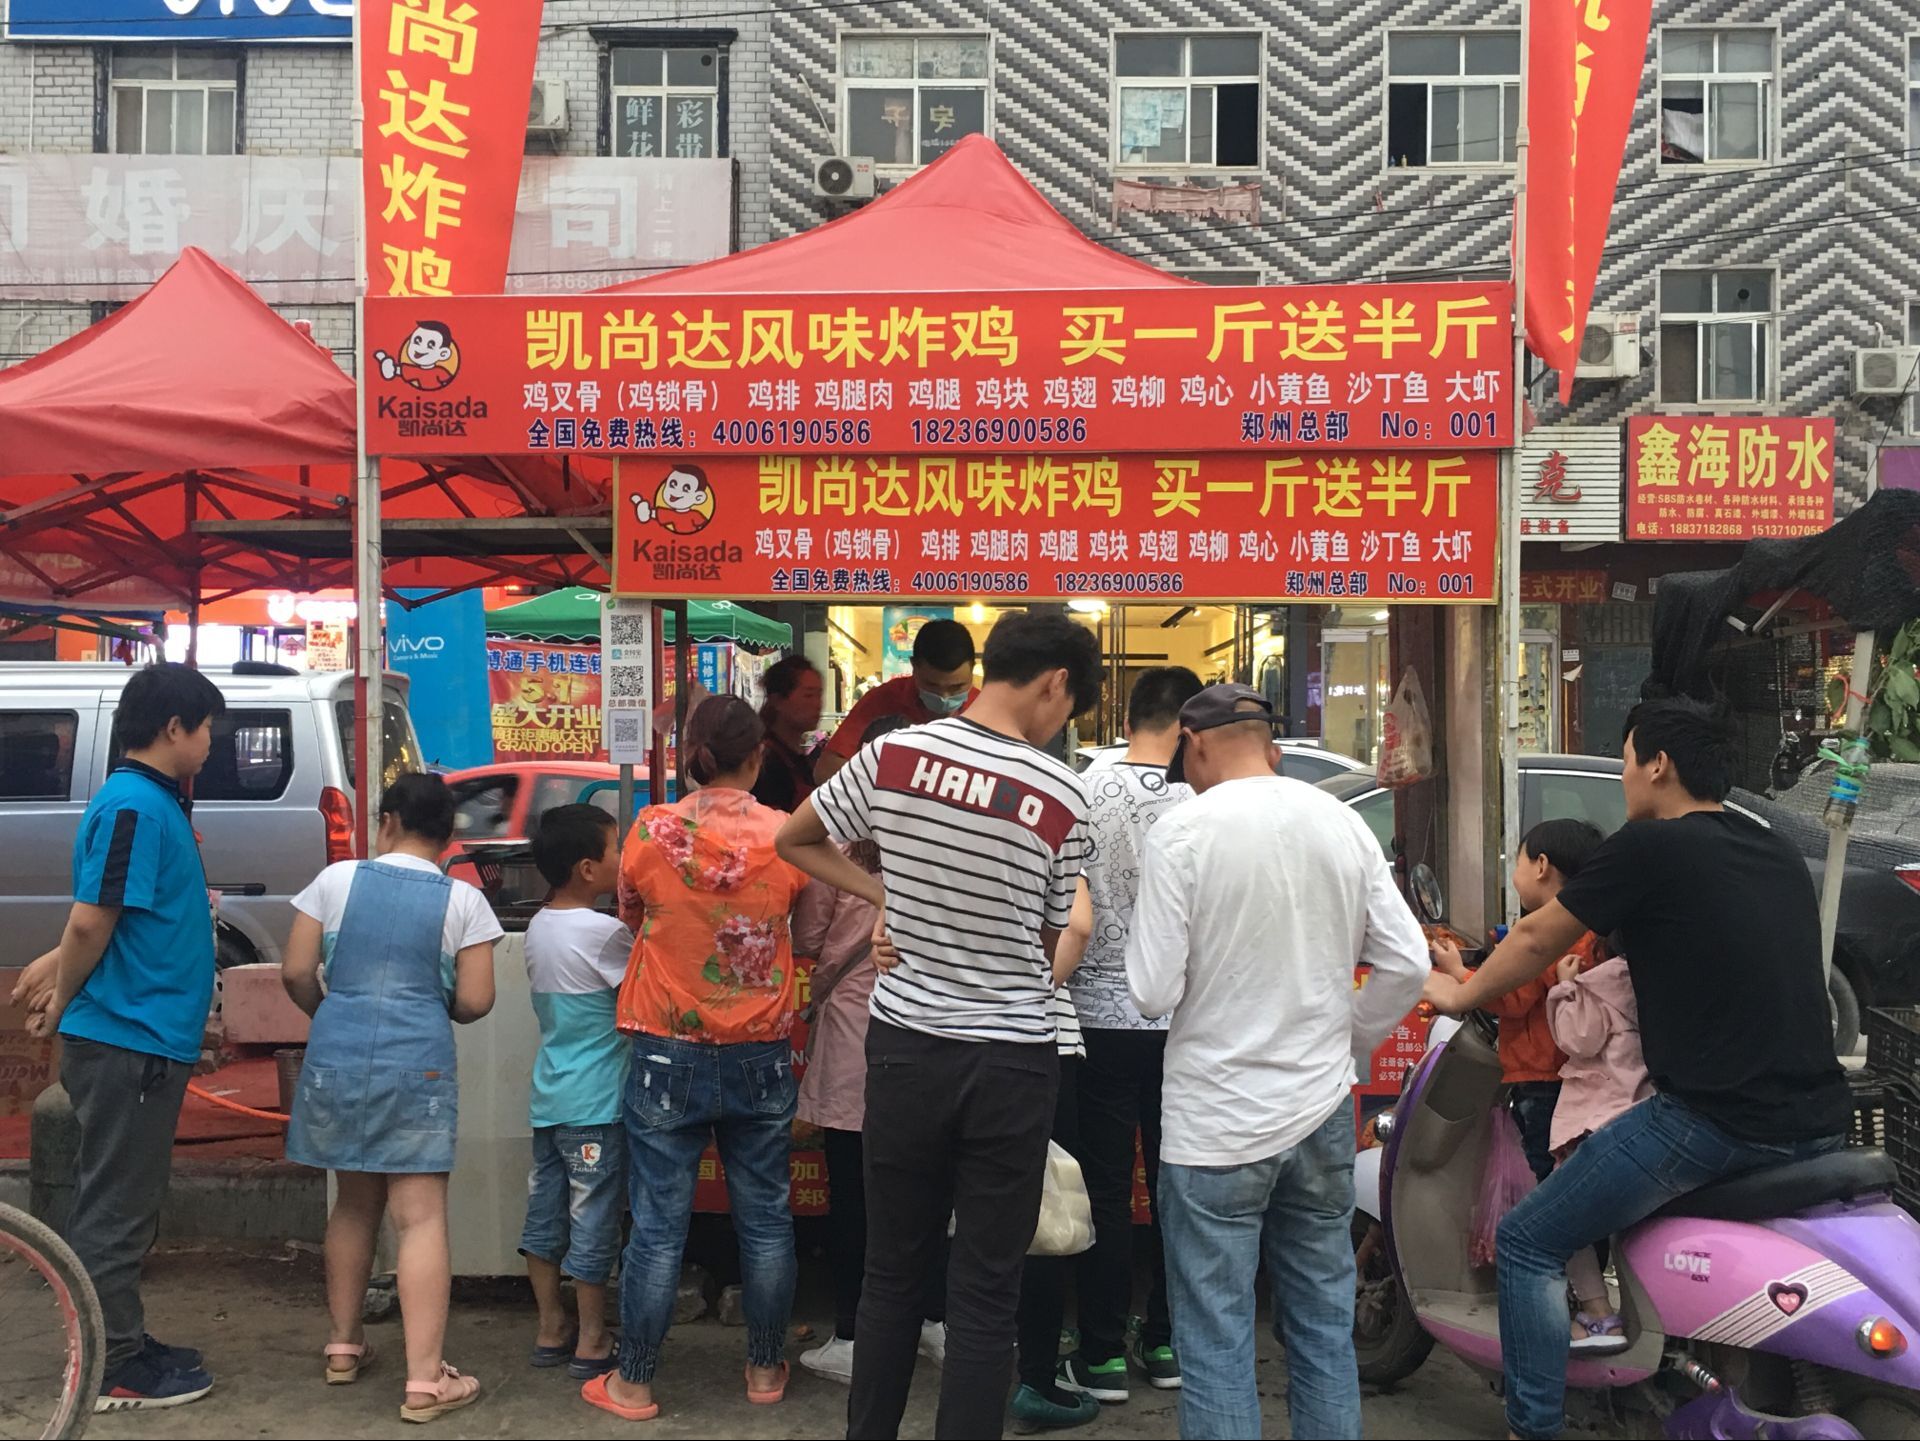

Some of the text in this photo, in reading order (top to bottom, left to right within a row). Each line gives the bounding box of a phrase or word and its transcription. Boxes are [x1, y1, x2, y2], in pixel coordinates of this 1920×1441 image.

[625, 97, 654, 158] 鲜花
[525, 296, 1498, 370] 凯尚达风味炸鸡 买一斤送半斤
[748, 379, 801, 412] 鸡排
[814, 378, 893, 411] 鸡腿肉
[908, 378, 961, 411] 鸡腿
[975, 377, 1029, 410] 鸡块
[1043, 376, 1098, 410] 鸡翅
[1111, 375, 1166, 409] 鸡柳
[1180, 374, 1234, 408] 鸡心
[1249, 372, 1332, 406] 小黄鱼
[1346, 371, 1430, 404] 沙丁鱼
[1445, 369, 1501, 404] 大虾
[378, 396, 488, 419] Kaisada
[398, 420, 468, 437] 凯尚达
[712, 418, 872, 446] 4006190586
[910, 415, 1088, 445] 18236900586
[1240, 410, 1350, 443] 郑州总部
[1450, 411, 1497, 439] 001
[1637, 422, 1830, 489] 鑫海防水
[758, 455, 1471, 518] 凯尚达风味炸鸡 买一斤送半斤
[1670, 523, 1743, 535] 18837182868
[632, 539, 743, 563] Kaisada
[921, 528, 961, 561] 鸡排
[970, 528, 1029, 562] 鸡腿肉
[1039, 529, 1079, 562] 鸡腿
[1089, 529, 1129, 562] 鸡块
[1138, 529, 1178, 563] 鸡翅
[1188, 529, 1229, 563] 鸡柳
[1239, 530, 1279, 563] 鸡心
[1289, 530, 1350, 563] 小黄鱼
[1360, 530, 1421, 562] 沙丁鱼
[1431, 529, 1473, 563] 大虾
[652, 563, 722, 581] 凯尚达
[911, 571, 1030, 593] 4006190586
[1054, 571, 1183, 593] 18236900586
[1285, 571, 1369, 596] 郑州总部
[1438, 573, 1474, 594] 001
[389, 634, 445, 653] vivo
[491, 703, 602, 730] 盛大开业
[497, 741, 594, 754] GRAND OPEN
[584, 1146, 595, 1159] K
[1664, 1253, 1712, 1275] LOVE
